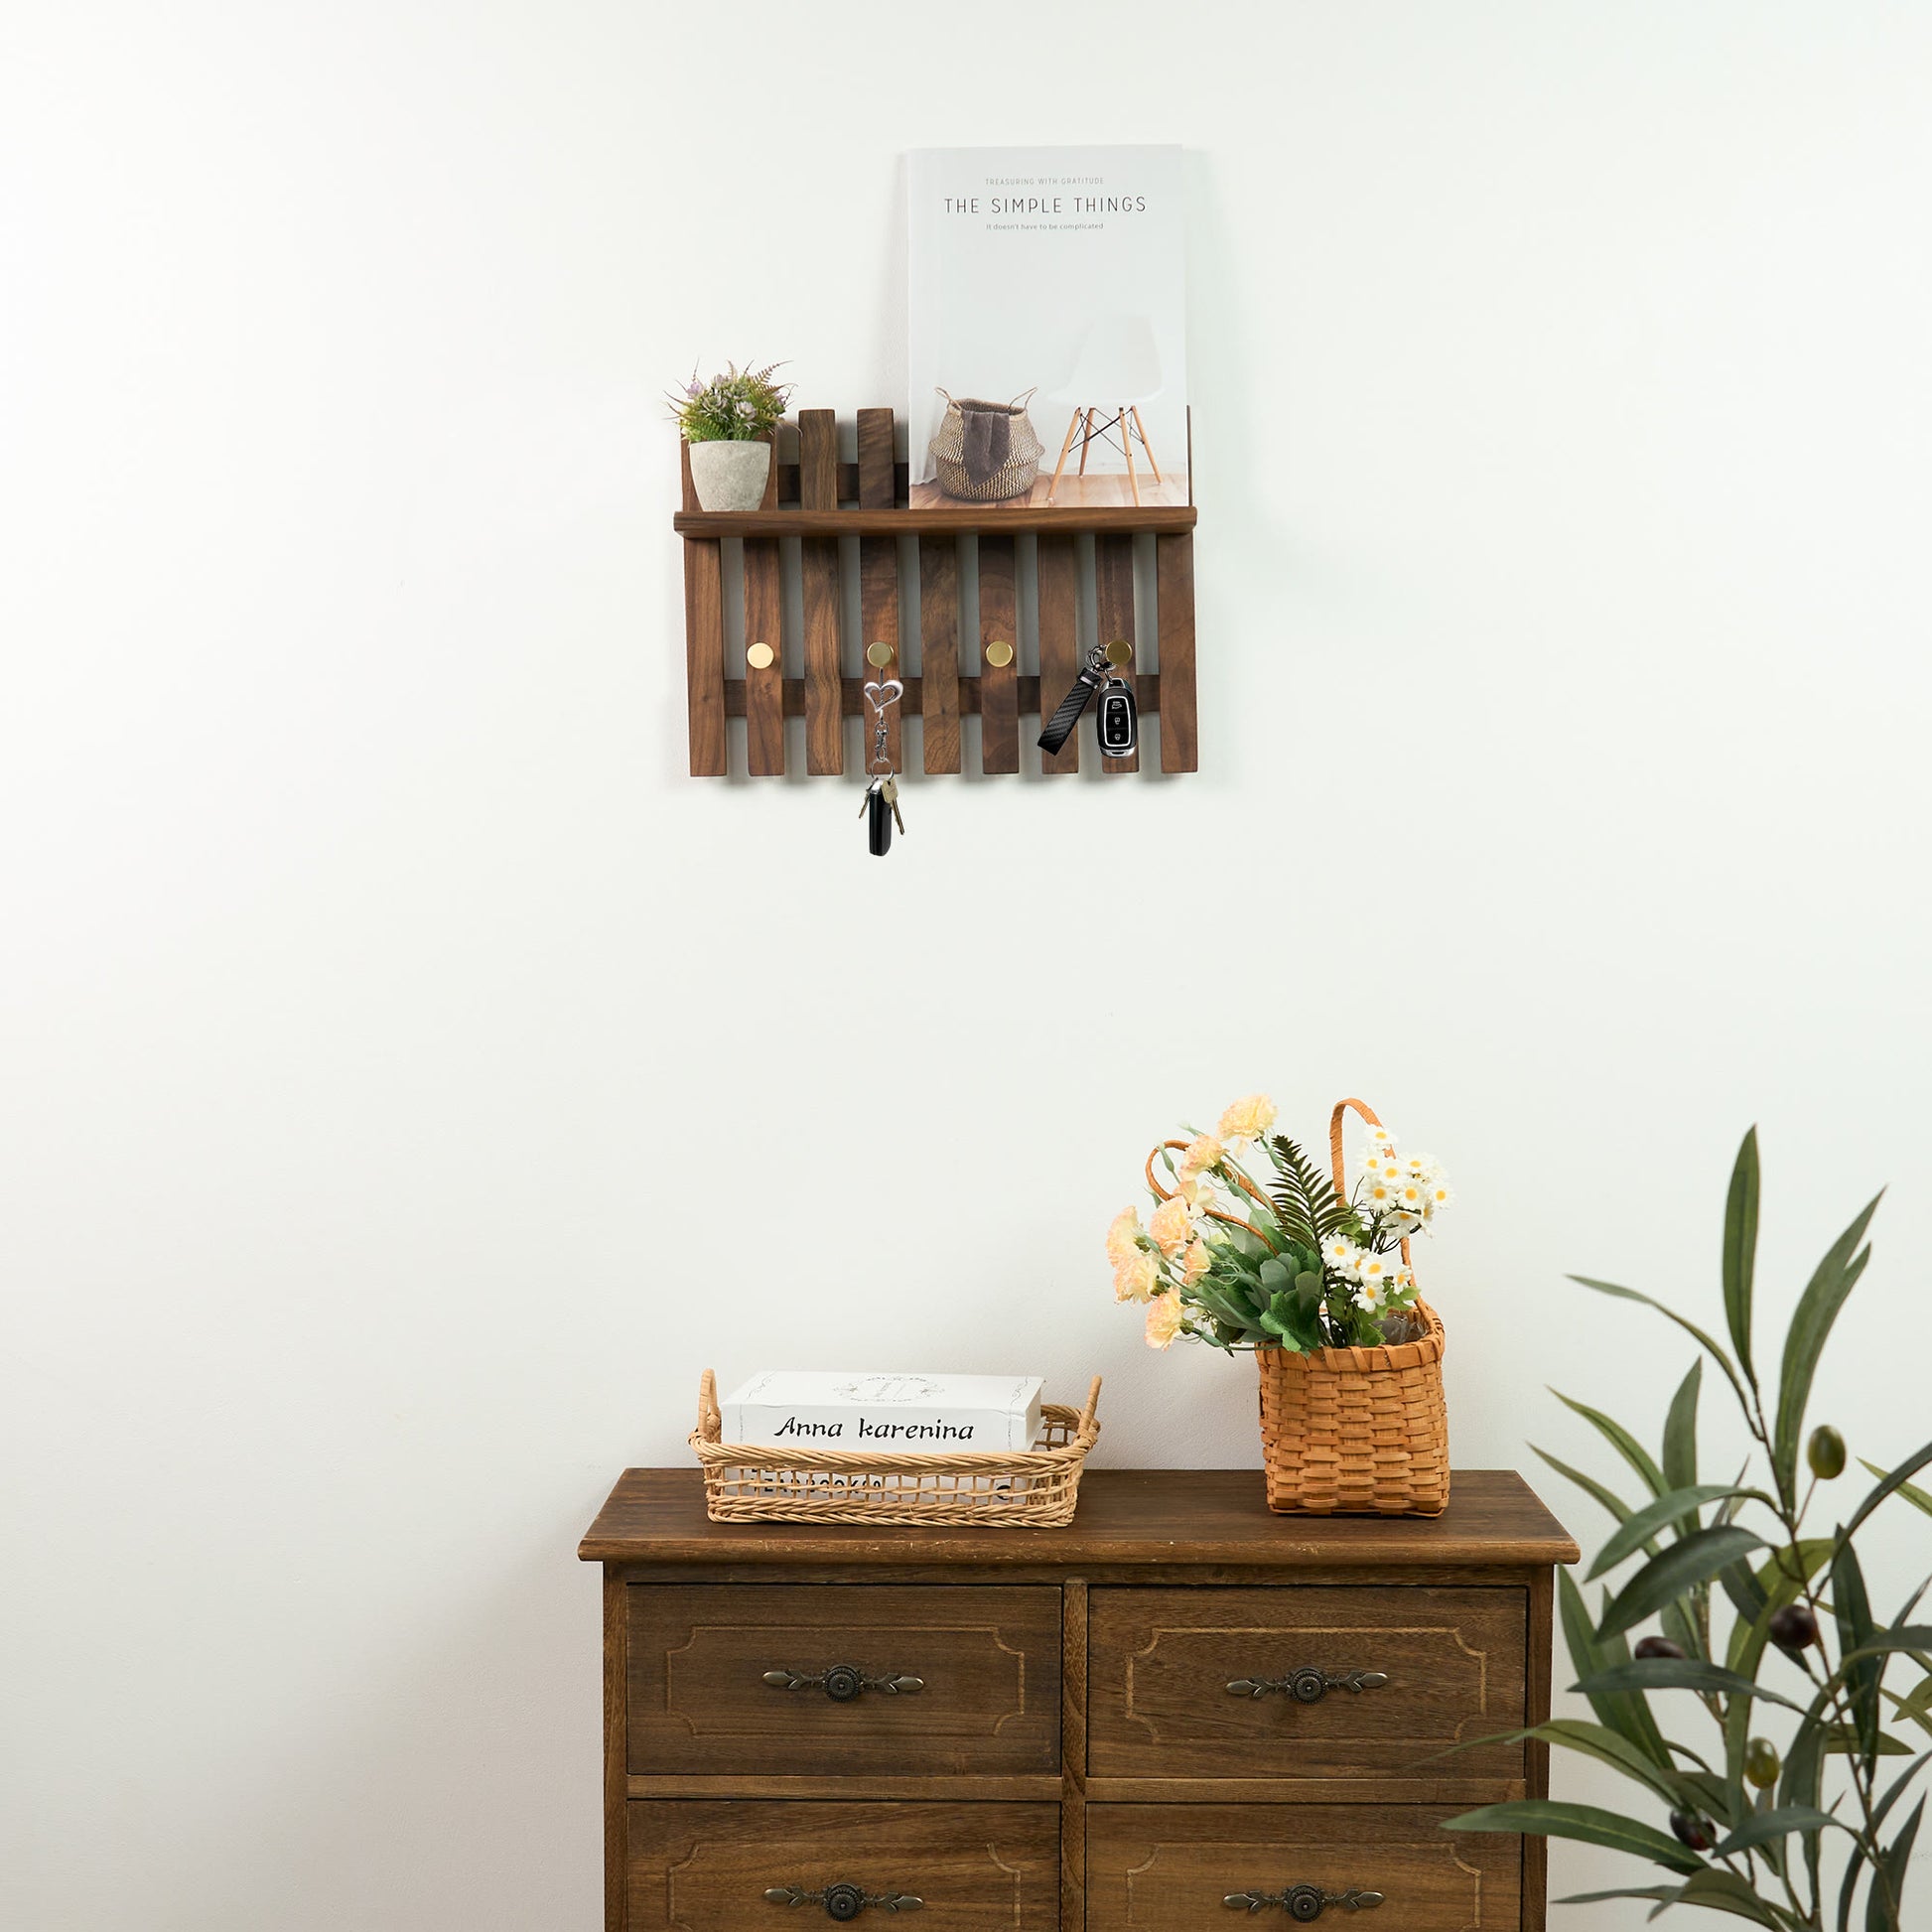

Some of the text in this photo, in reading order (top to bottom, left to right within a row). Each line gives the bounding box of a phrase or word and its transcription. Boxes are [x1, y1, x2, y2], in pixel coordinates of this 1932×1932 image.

[944, 197, 1146, 213] THE SIMPLE THINGS
[1059, 222, 1104, 231] complicated
[773, 1416, 974, 1441] Anna karenina
